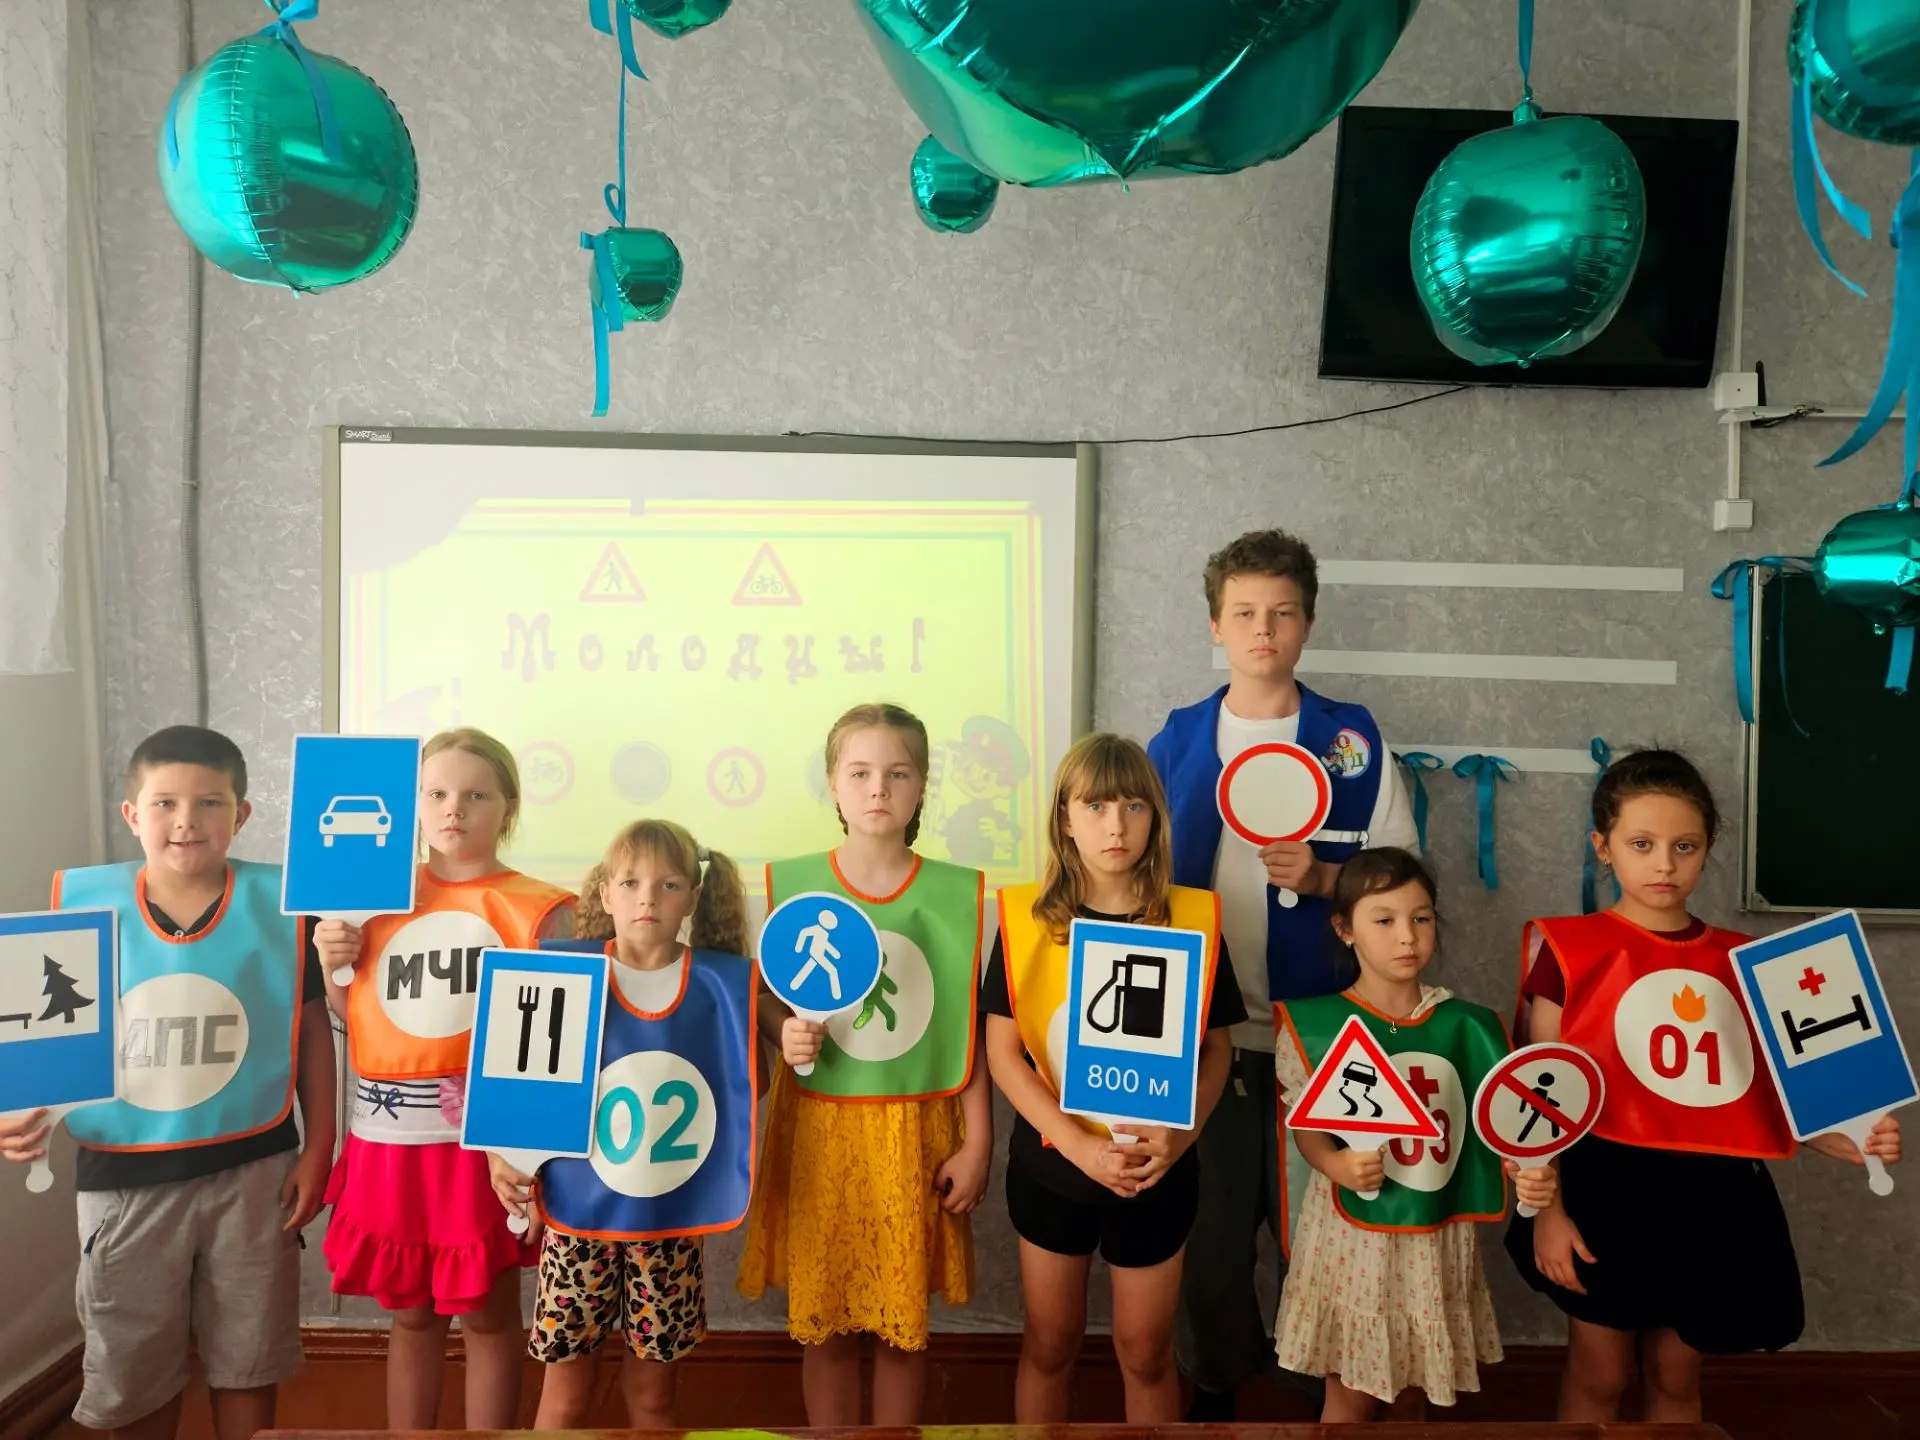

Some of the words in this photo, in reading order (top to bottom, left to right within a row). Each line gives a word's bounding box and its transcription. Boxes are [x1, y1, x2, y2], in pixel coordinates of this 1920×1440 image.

[345, 430, 372, 439] SMART
[120, 1015, 239, 1069] ДПС
[1649, 1024, 1721, 1086] 01
[1087, 1064, 1139, 1093] 800
[596, 1080, 699, 1165] 02
